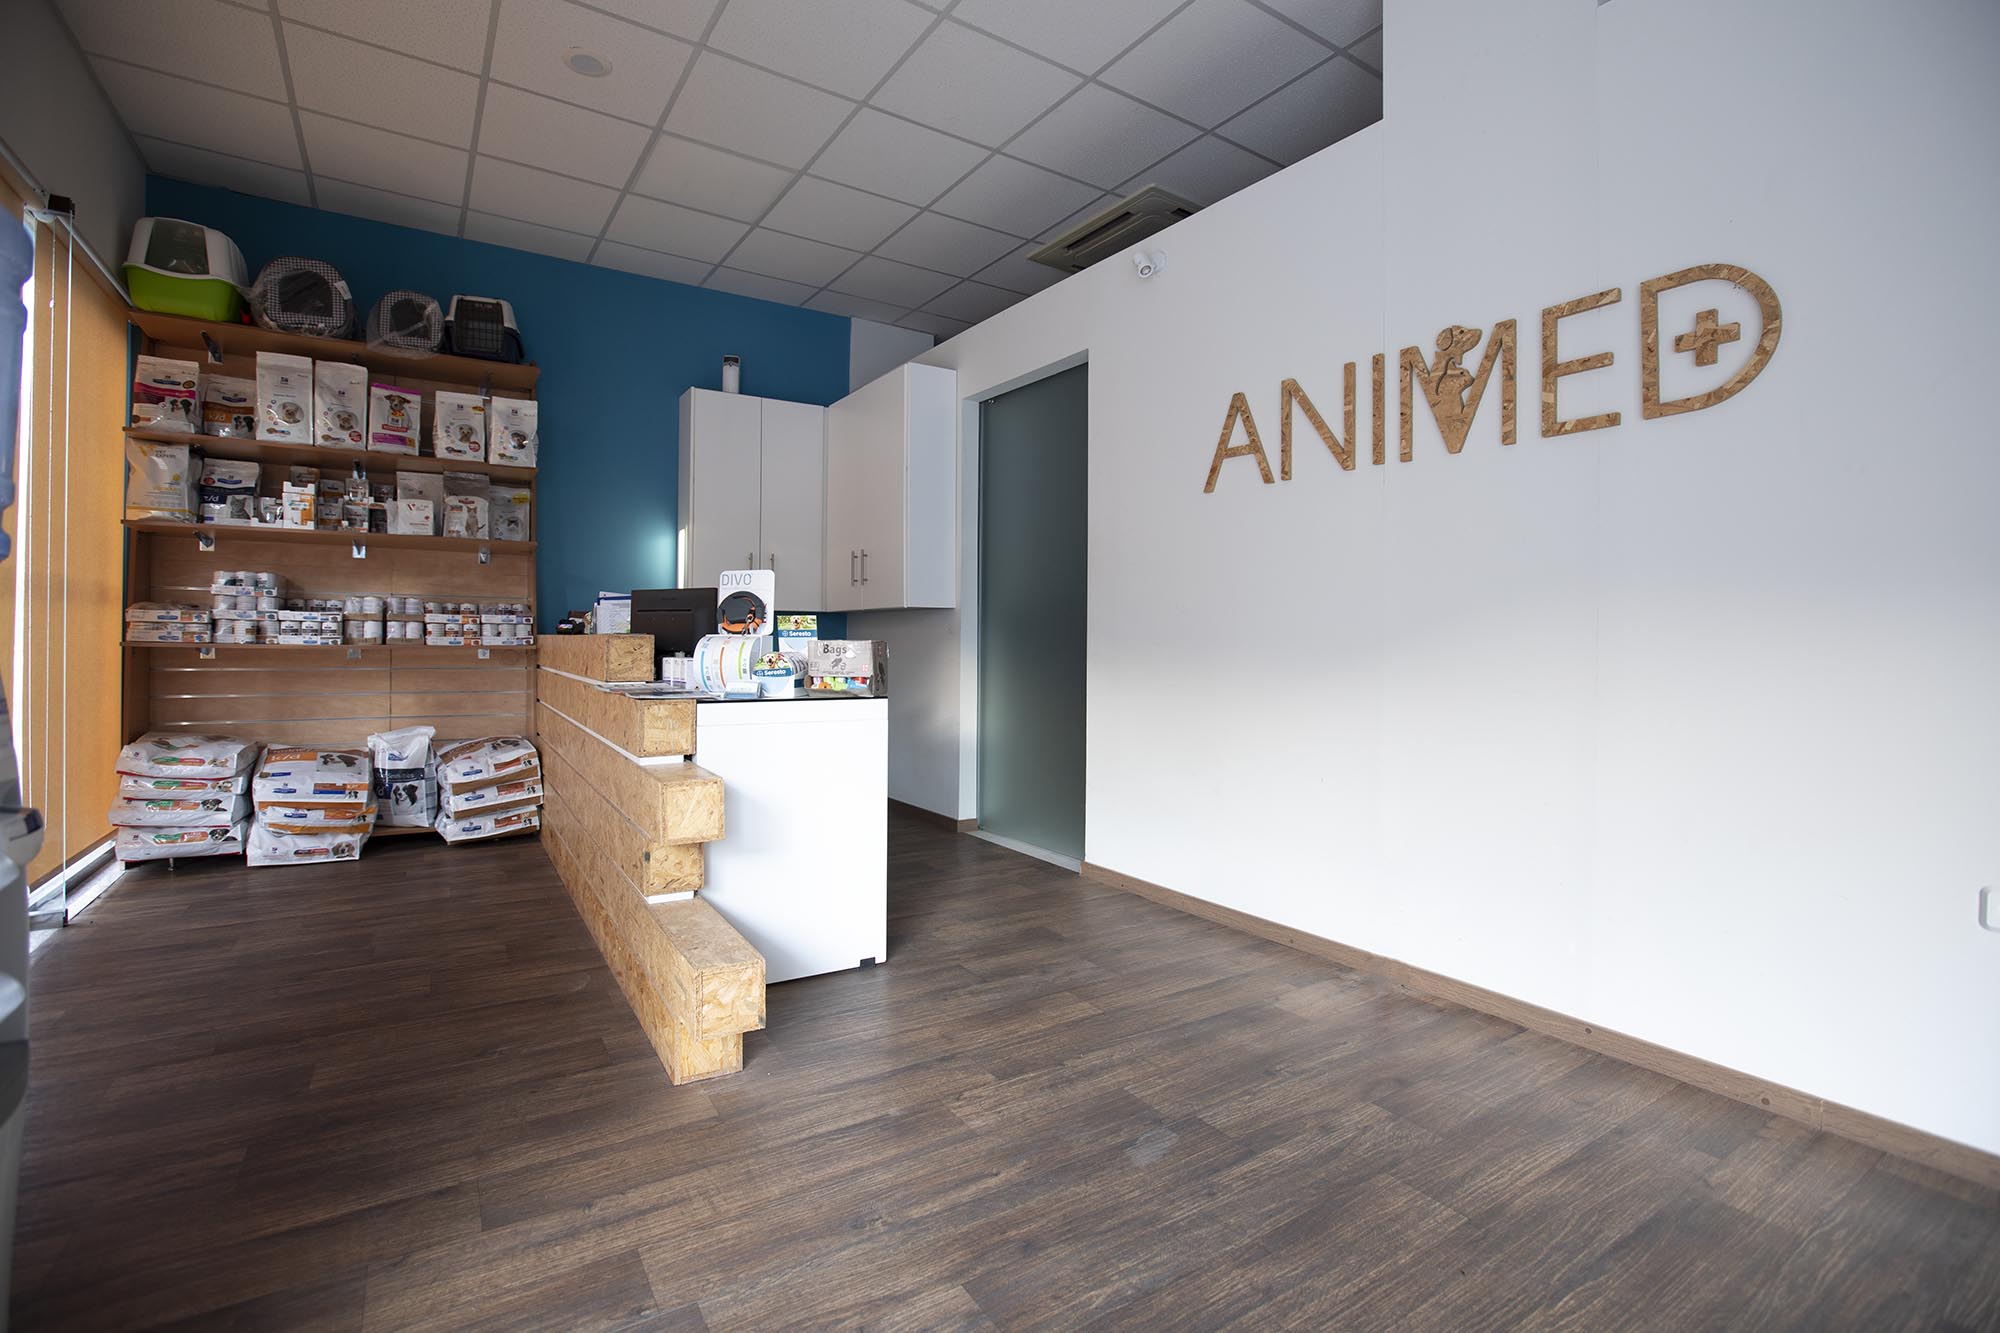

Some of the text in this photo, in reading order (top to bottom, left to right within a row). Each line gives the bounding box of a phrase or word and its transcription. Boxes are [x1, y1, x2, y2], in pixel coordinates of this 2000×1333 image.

[1203, 263, 1782, 494] ANIMED
[721, 574, 752, 586] DIVO
[823, 644, 848, 657] Bags
